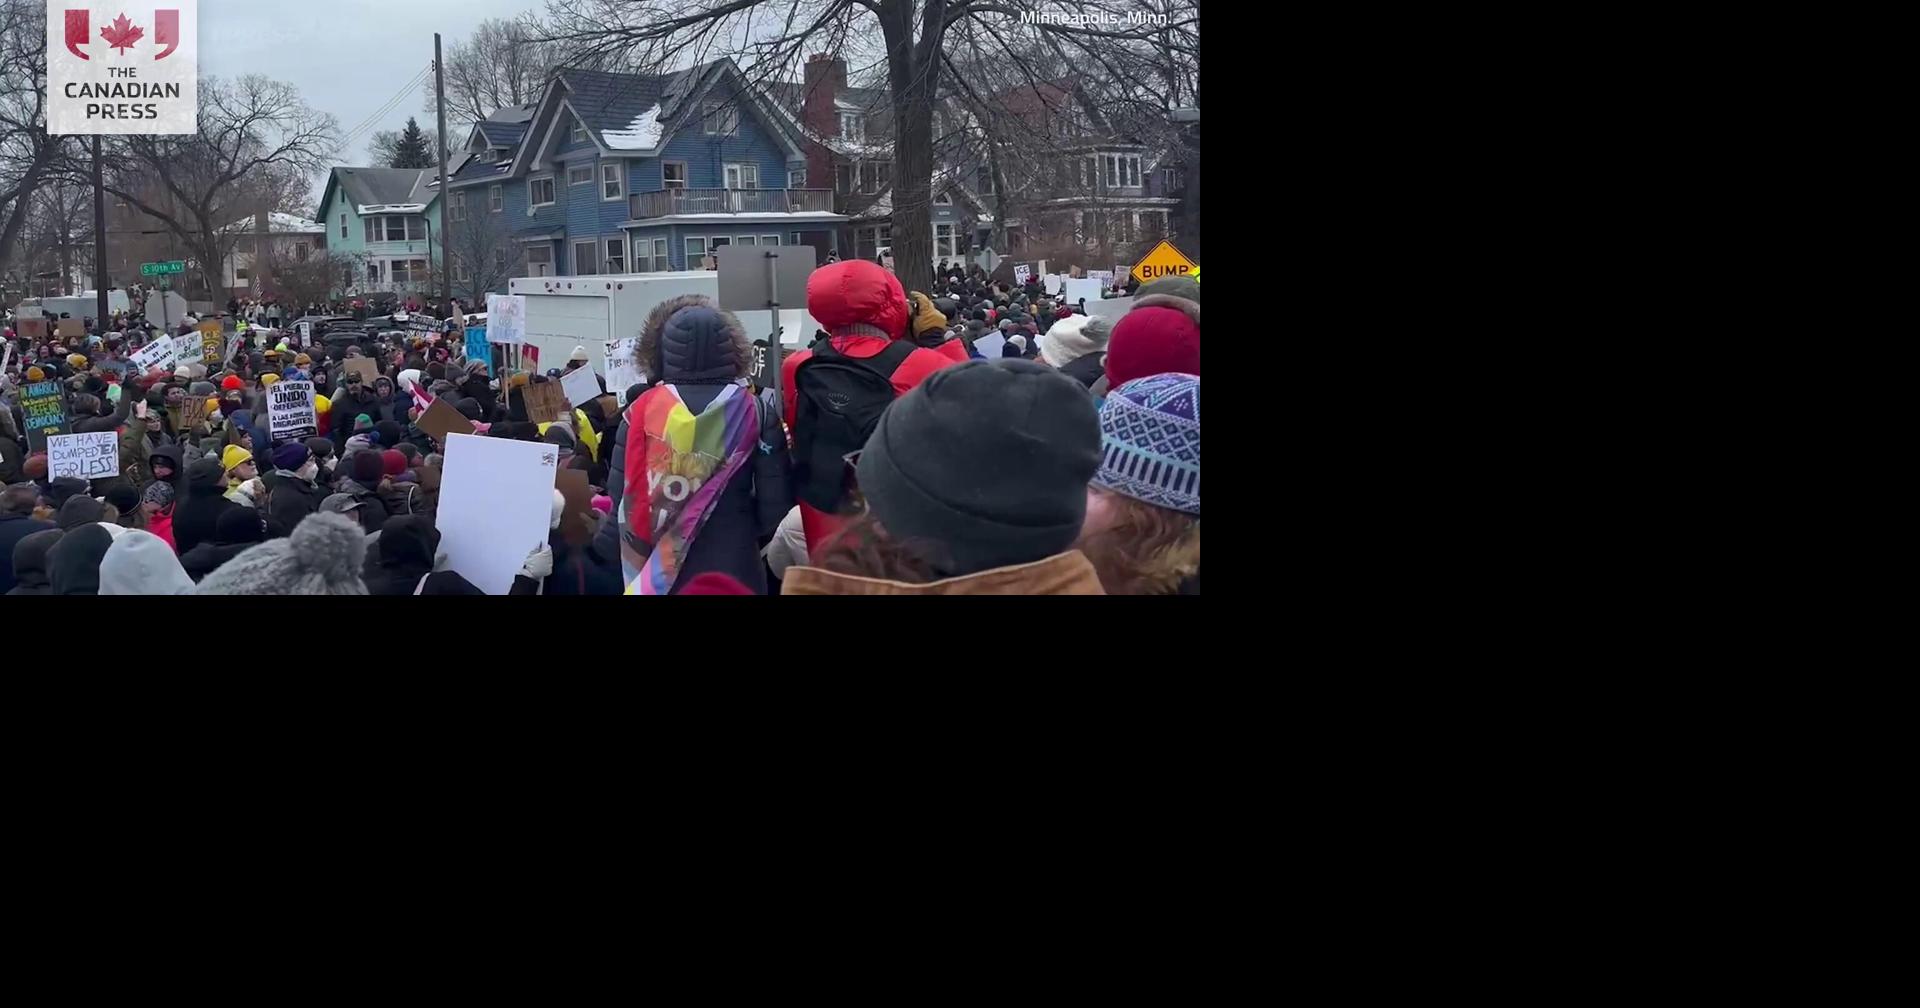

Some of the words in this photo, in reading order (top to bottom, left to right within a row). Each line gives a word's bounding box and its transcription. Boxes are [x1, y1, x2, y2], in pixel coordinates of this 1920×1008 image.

[143, 265, 150, 274] S
[1015, 266, 1029, 275] ICE
[1142, 265, 1189, 278] BUMP
[467, 344, 490, 358] OUT
[28, 382, 59, 398] AMERICA
[284, 383, 310, 392] PUEBLO
[274, 390, 307, 404] UNIDO
[29, 401, 61, 417] DEFEND
[49, 435, 71, 448] WE
[76, 432, 113, 447] HAVE
[52, 446, 99, 461] DUMPED
[97, 443, 117, 455] TEA
[53, 462, 79, 477] FOR
